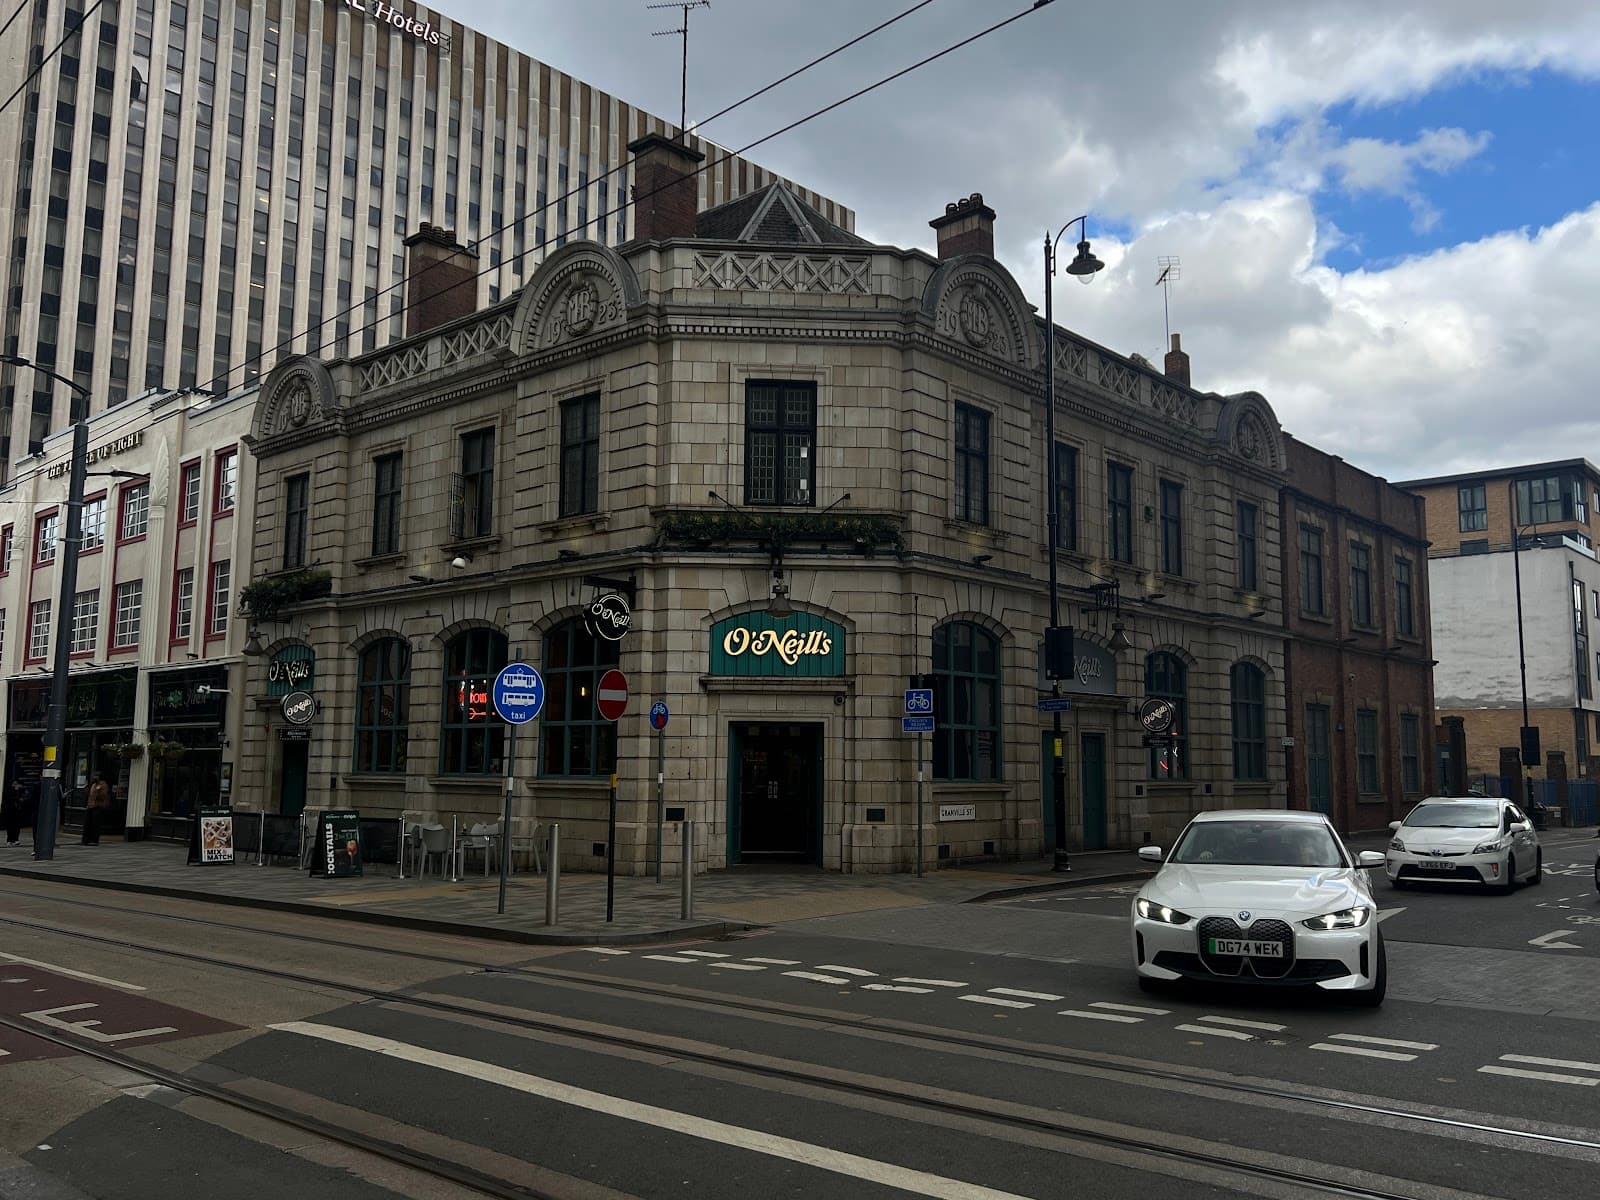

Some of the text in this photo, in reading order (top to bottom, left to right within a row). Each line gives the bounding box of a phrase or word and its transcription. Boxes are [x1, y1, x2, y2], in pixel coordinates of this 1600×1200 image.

[374, 1, 440, 45] Hotels
[112, 431, 142, 454] EIGHT
[723, 627, 832, 665] O'Neill's
[511, 711, 526, 720] taxi
[1218, 941, 1280, 955] DG74 WEK
